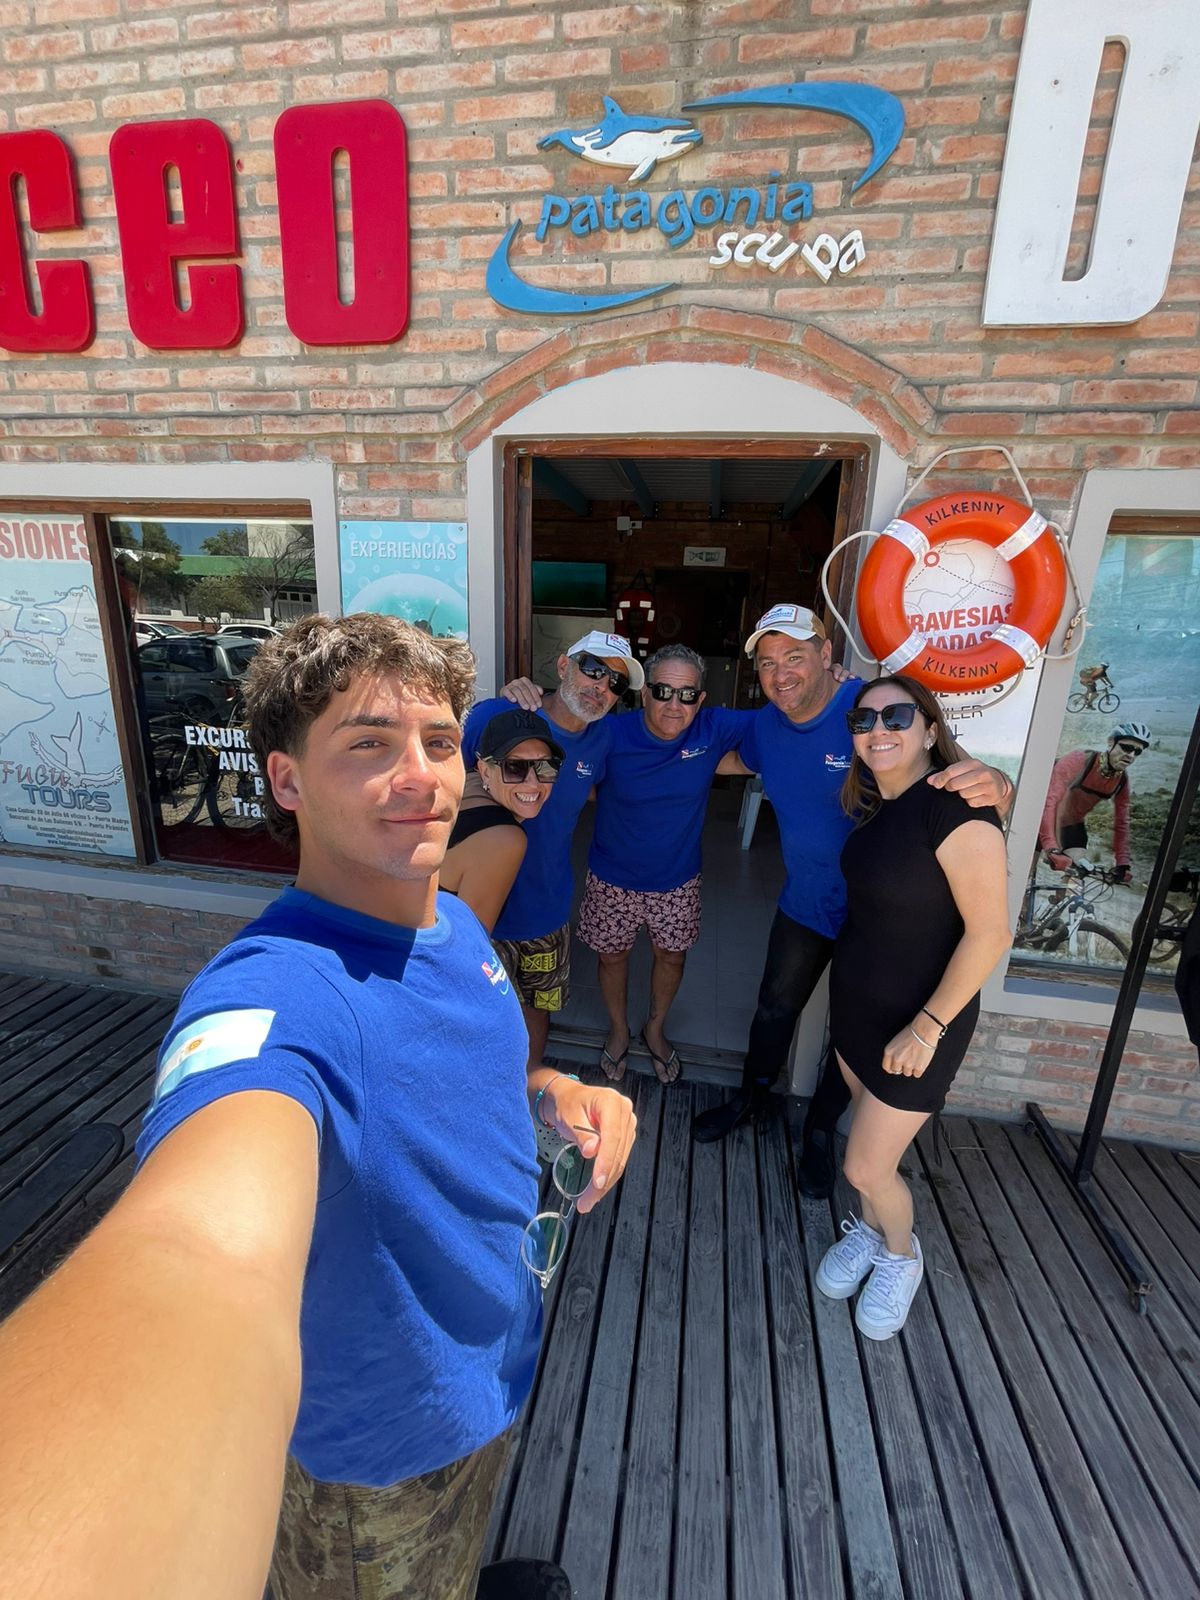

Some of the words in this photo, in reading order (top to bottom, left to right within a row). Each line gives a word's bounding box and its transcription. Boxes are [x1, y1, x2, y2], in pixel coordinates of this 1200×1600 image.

[535, 170, 813, 249] patagonia
[709, 230, 865, 284] scuba
[925, 501, 1005, 526] KILKENNY
[351, 540, 457, 560] EXPERIENCIAS
[923, 657, 998, 678] KILKENNY
[21, 784, 112, 813] TOURS
[231, 797, 266, 819] Tra
